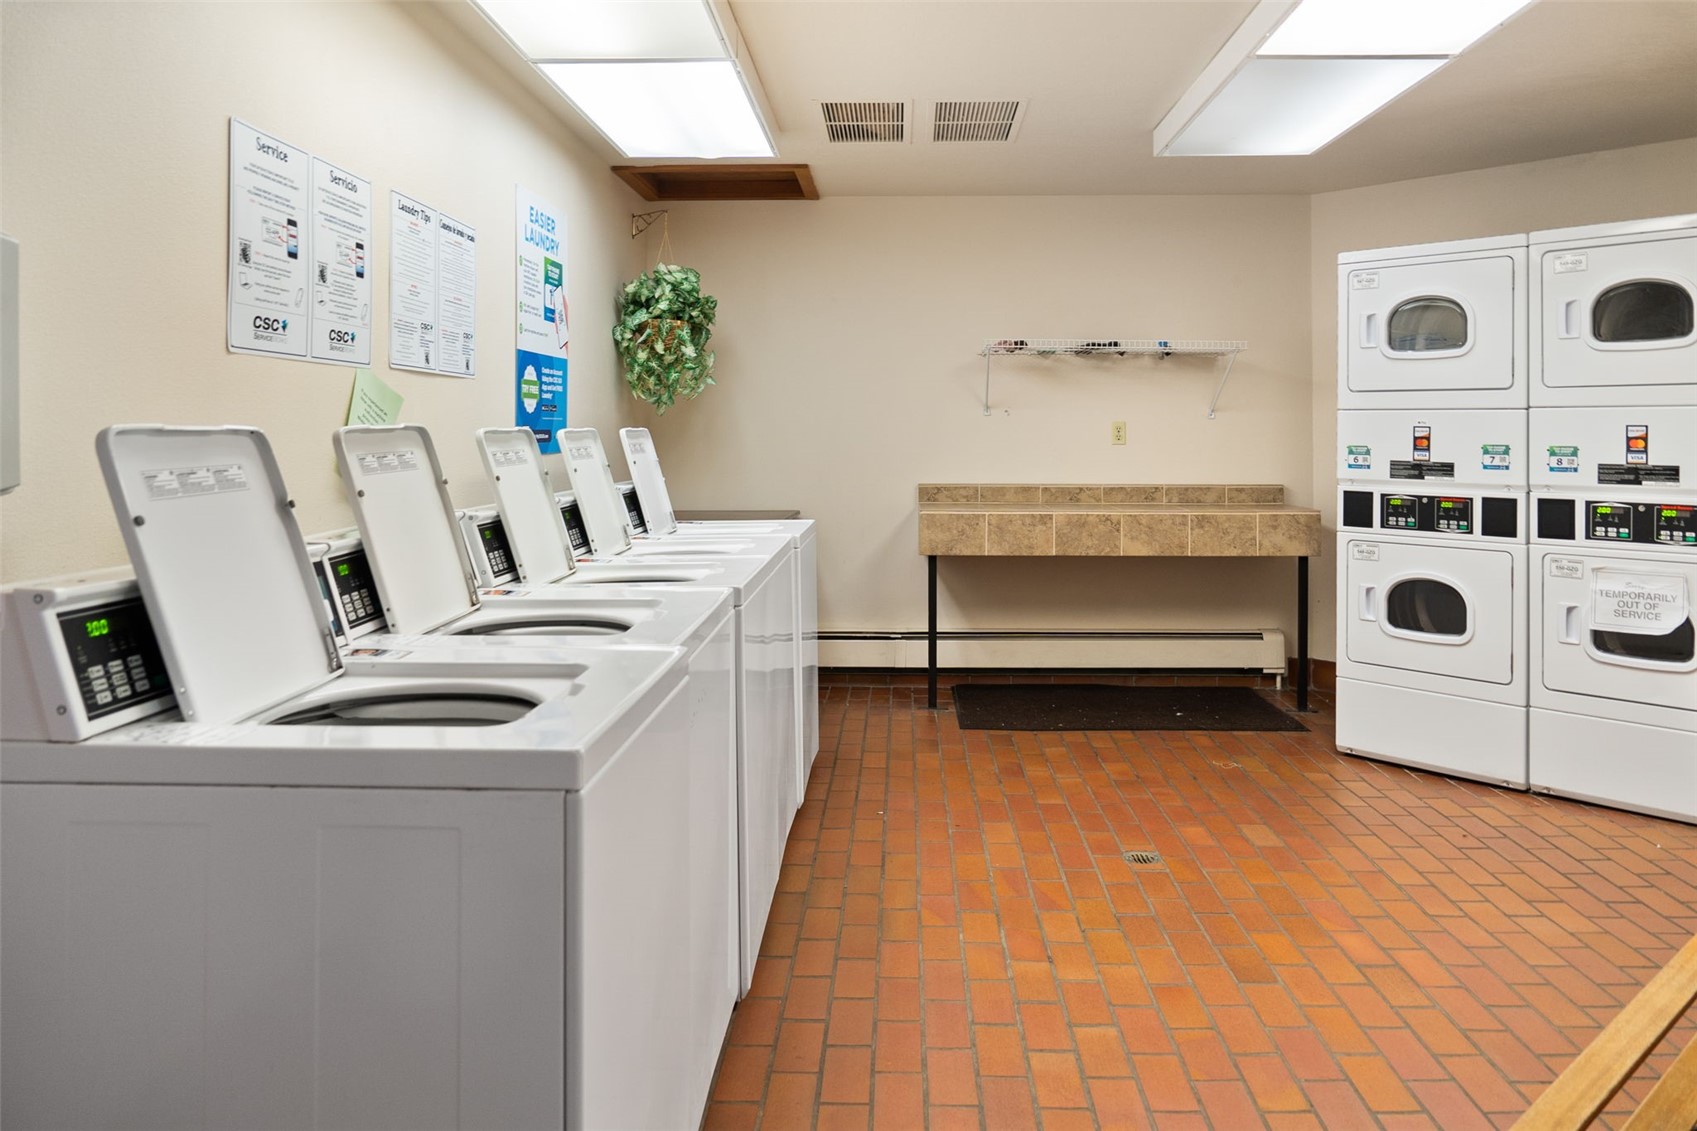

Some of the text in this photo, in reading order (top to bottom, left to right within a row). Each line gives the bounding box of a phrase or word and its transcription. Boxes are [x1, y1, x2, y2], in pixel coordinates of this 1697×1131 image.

[256, 136, 288, 163] Service
[329, 169, 358, 194] Servicio
[529, 205, 556, 236] EASIER
[524, 223, 560, 257] LAUNDRY
[252, 315, 280, 332] CSC
[328, 329, 350, 344] CSC
[1489, 456, 1496, 464] 7
[1556, 457, 1563, 466] 8
[1598, 589, 1678, 603] TEMPORARILY
[1617, 599, 1660, 611] OUT OF
[1613, 608, 1662, 621] SERVICE
